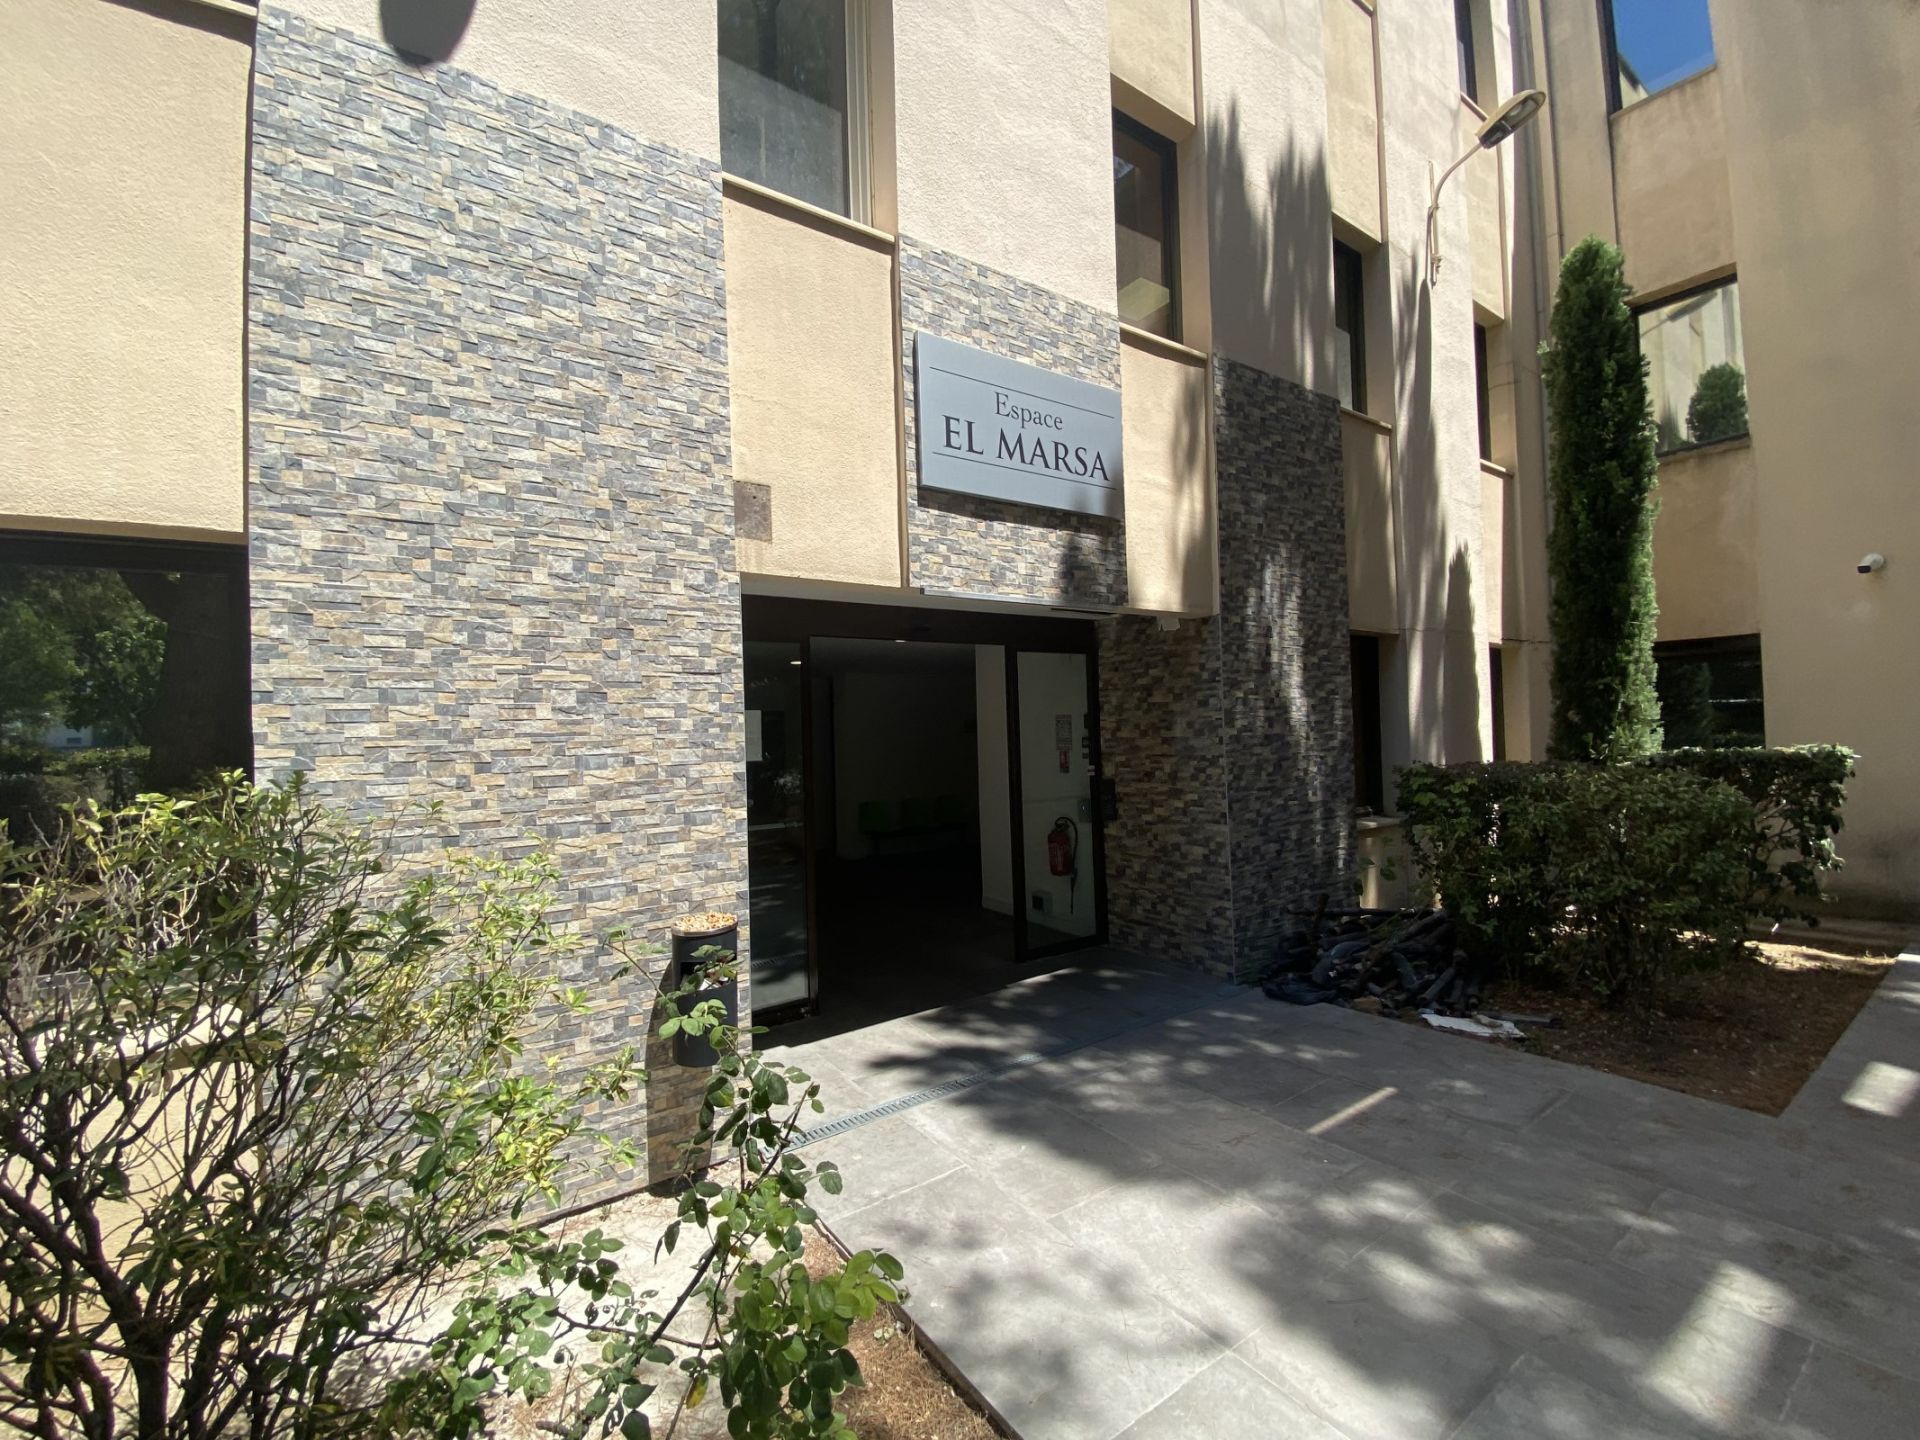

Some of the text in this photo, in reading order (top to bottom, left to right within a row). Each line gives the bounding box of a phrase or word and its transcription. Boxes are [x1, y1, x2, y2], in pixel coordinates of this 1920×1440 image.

[994, 391, 1063, 430] Espace
[942, 414, 1109, 481] EL MARSA
